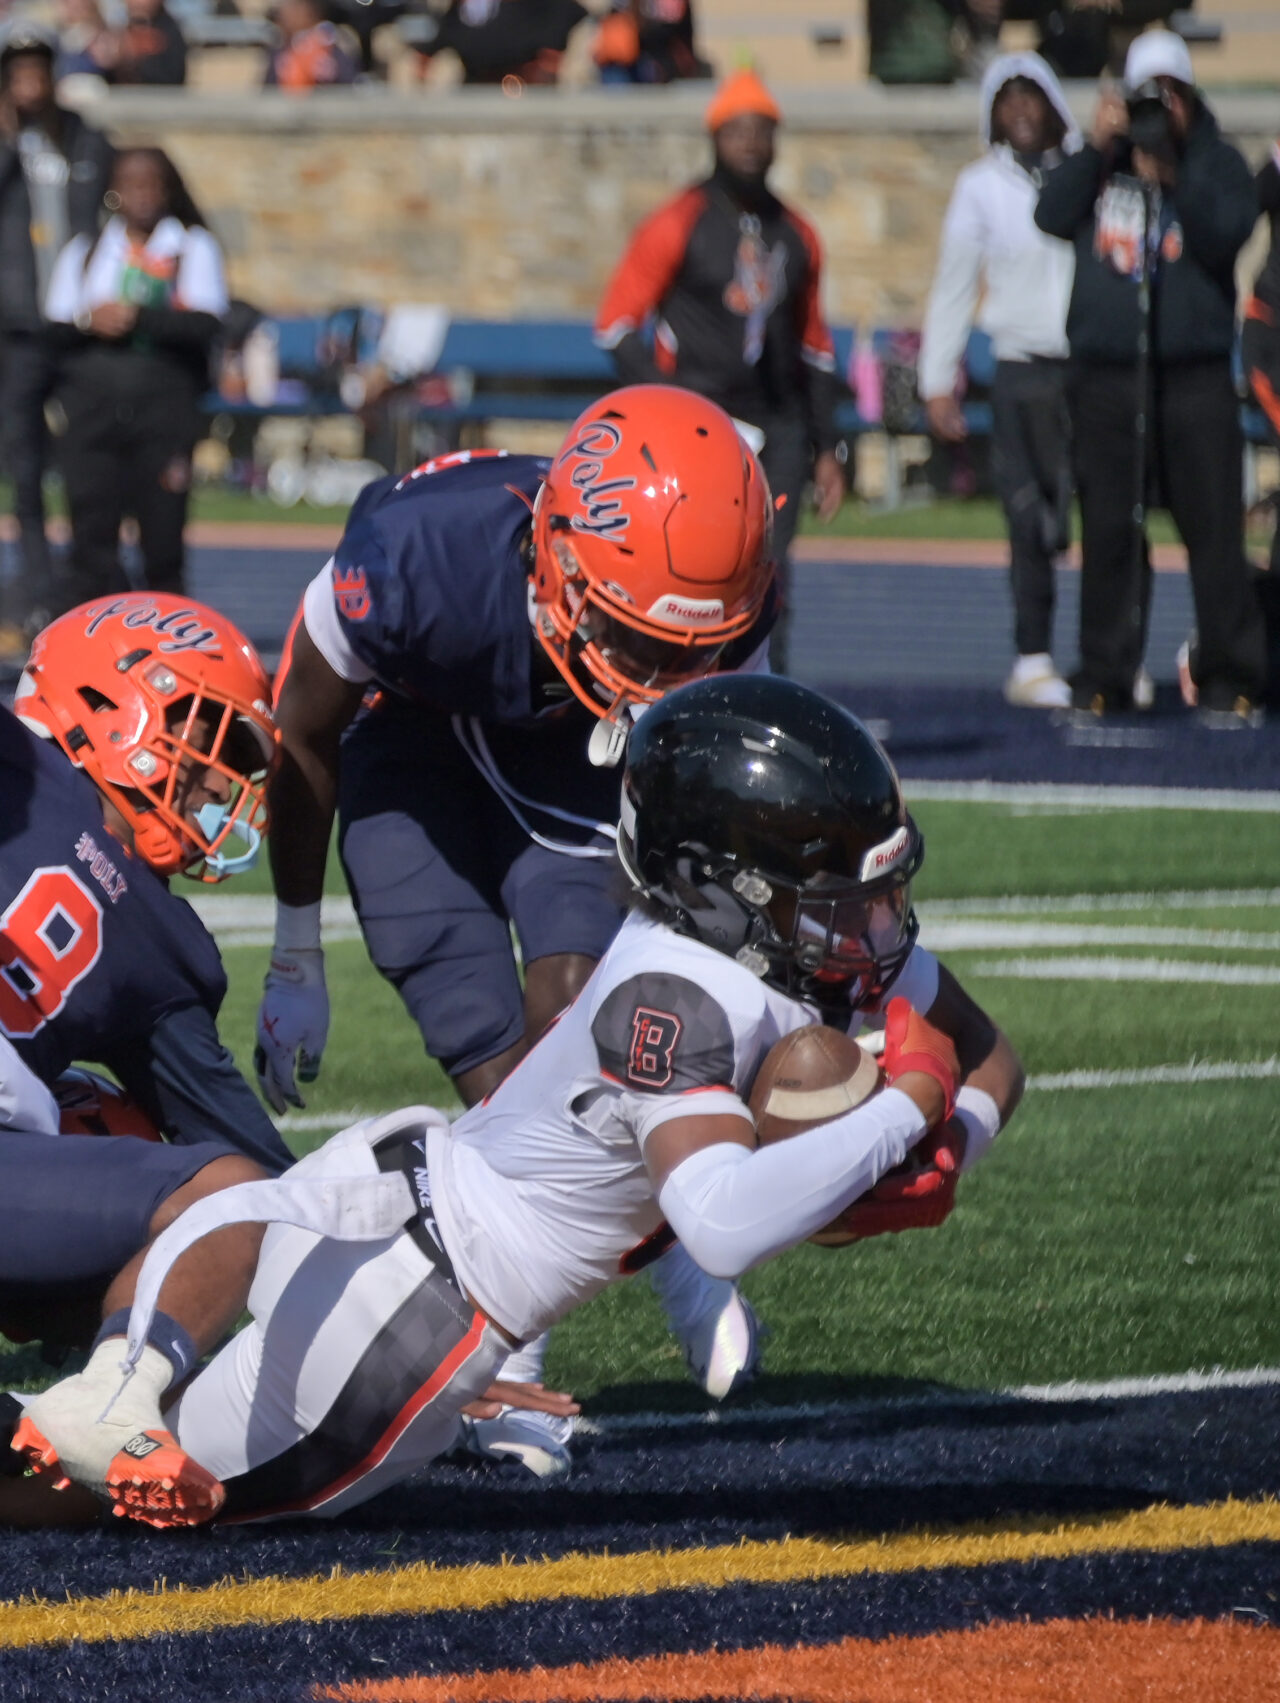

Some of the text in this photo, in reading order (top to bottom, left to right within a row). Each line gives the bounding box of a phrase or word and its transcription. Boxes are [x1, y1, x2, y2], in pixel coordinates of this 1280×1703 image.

[557, 419, 637, 542] Poly
[84, 598, 221, 653] Poly
[665, 602, 721, 619] Riddell
[74, 831, 128, 904] POLY
[628, 1006, 682, 1087] B
[413, 1166, 432, 1208] NIKE
